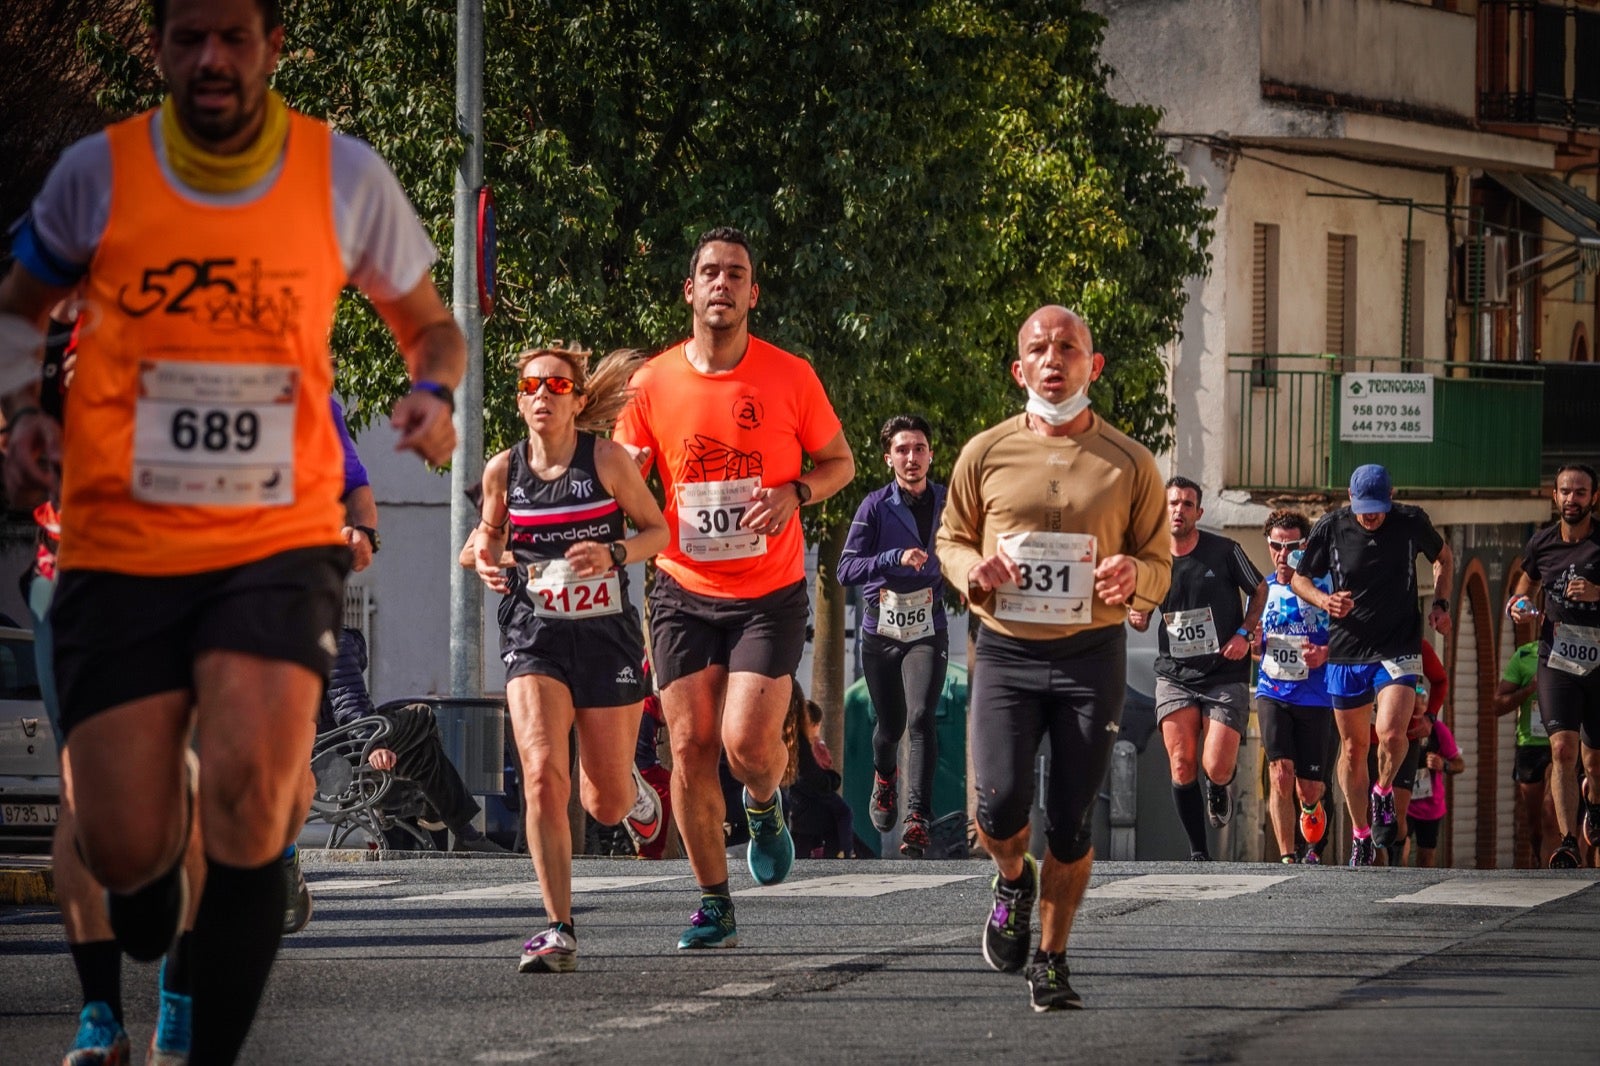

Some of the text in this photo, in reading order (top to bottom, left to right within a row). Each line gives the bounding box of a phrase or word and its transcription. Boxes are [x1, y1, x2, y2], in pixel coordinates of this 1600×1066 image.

[118, 257, 237, 318] 525
[1367, 379, 1426, 394] TECNOCASA
[1353, 404, 1421, 416] 958 070 366
[171, 408, 260, 453] 689
[1352, 421, 1421, 432] 644 793 485
[697, 506, 746, 534] 307
[1018, 563, 1070, 593] 331
[538, 582, 611, 613] 2124
[886, 608, 926, 627] 3056
[1176, 623, 1206, 642] 205
[1273, 650, 1297, 664] 505
[1559, 642, 1598, 662] 3080
[5, 806, 39, 822] 9735
